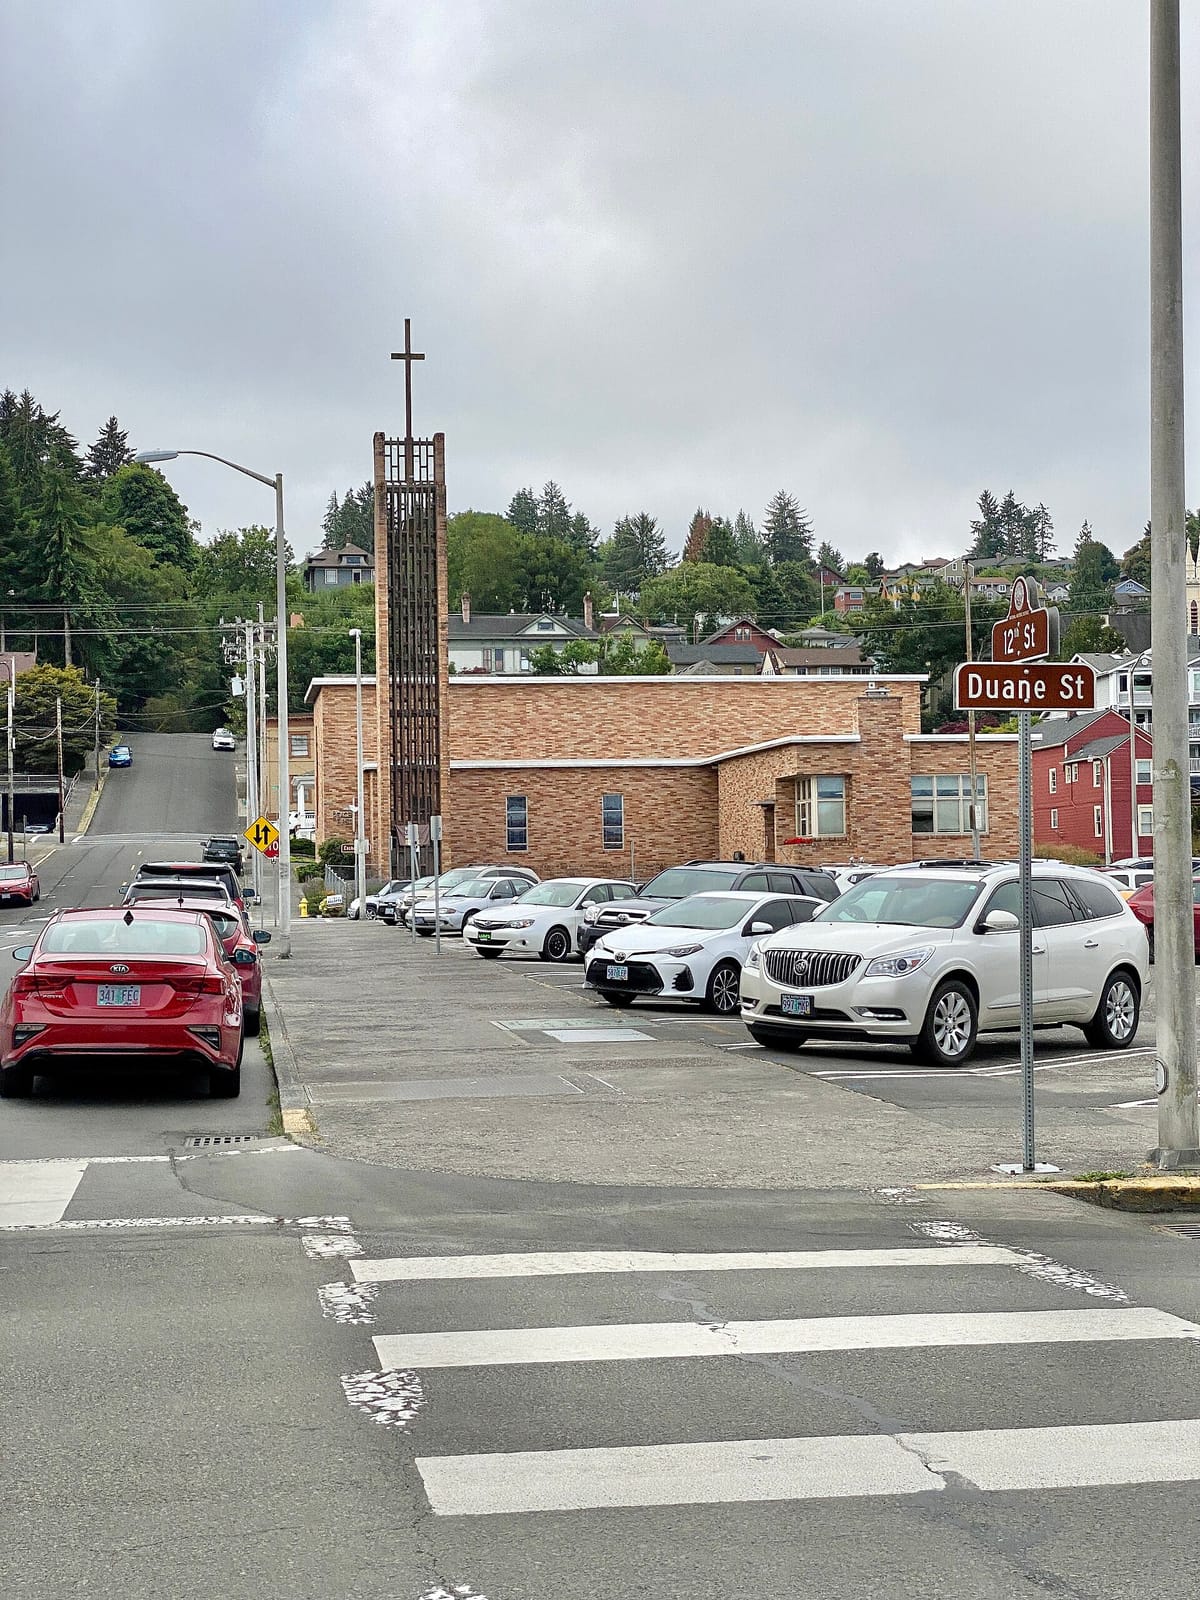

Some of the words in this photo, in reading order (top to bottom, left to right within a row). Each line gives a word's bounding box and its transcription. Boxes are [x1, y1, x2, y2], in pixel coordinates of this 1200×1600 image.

[1024, 623, 1035, 649] St
[968, 673, 1046, 699] Duane
[1059, 674, 1085, 700] St
[99, 990, 115, 1001] 341
[783, 999, 795, 1010] 997
